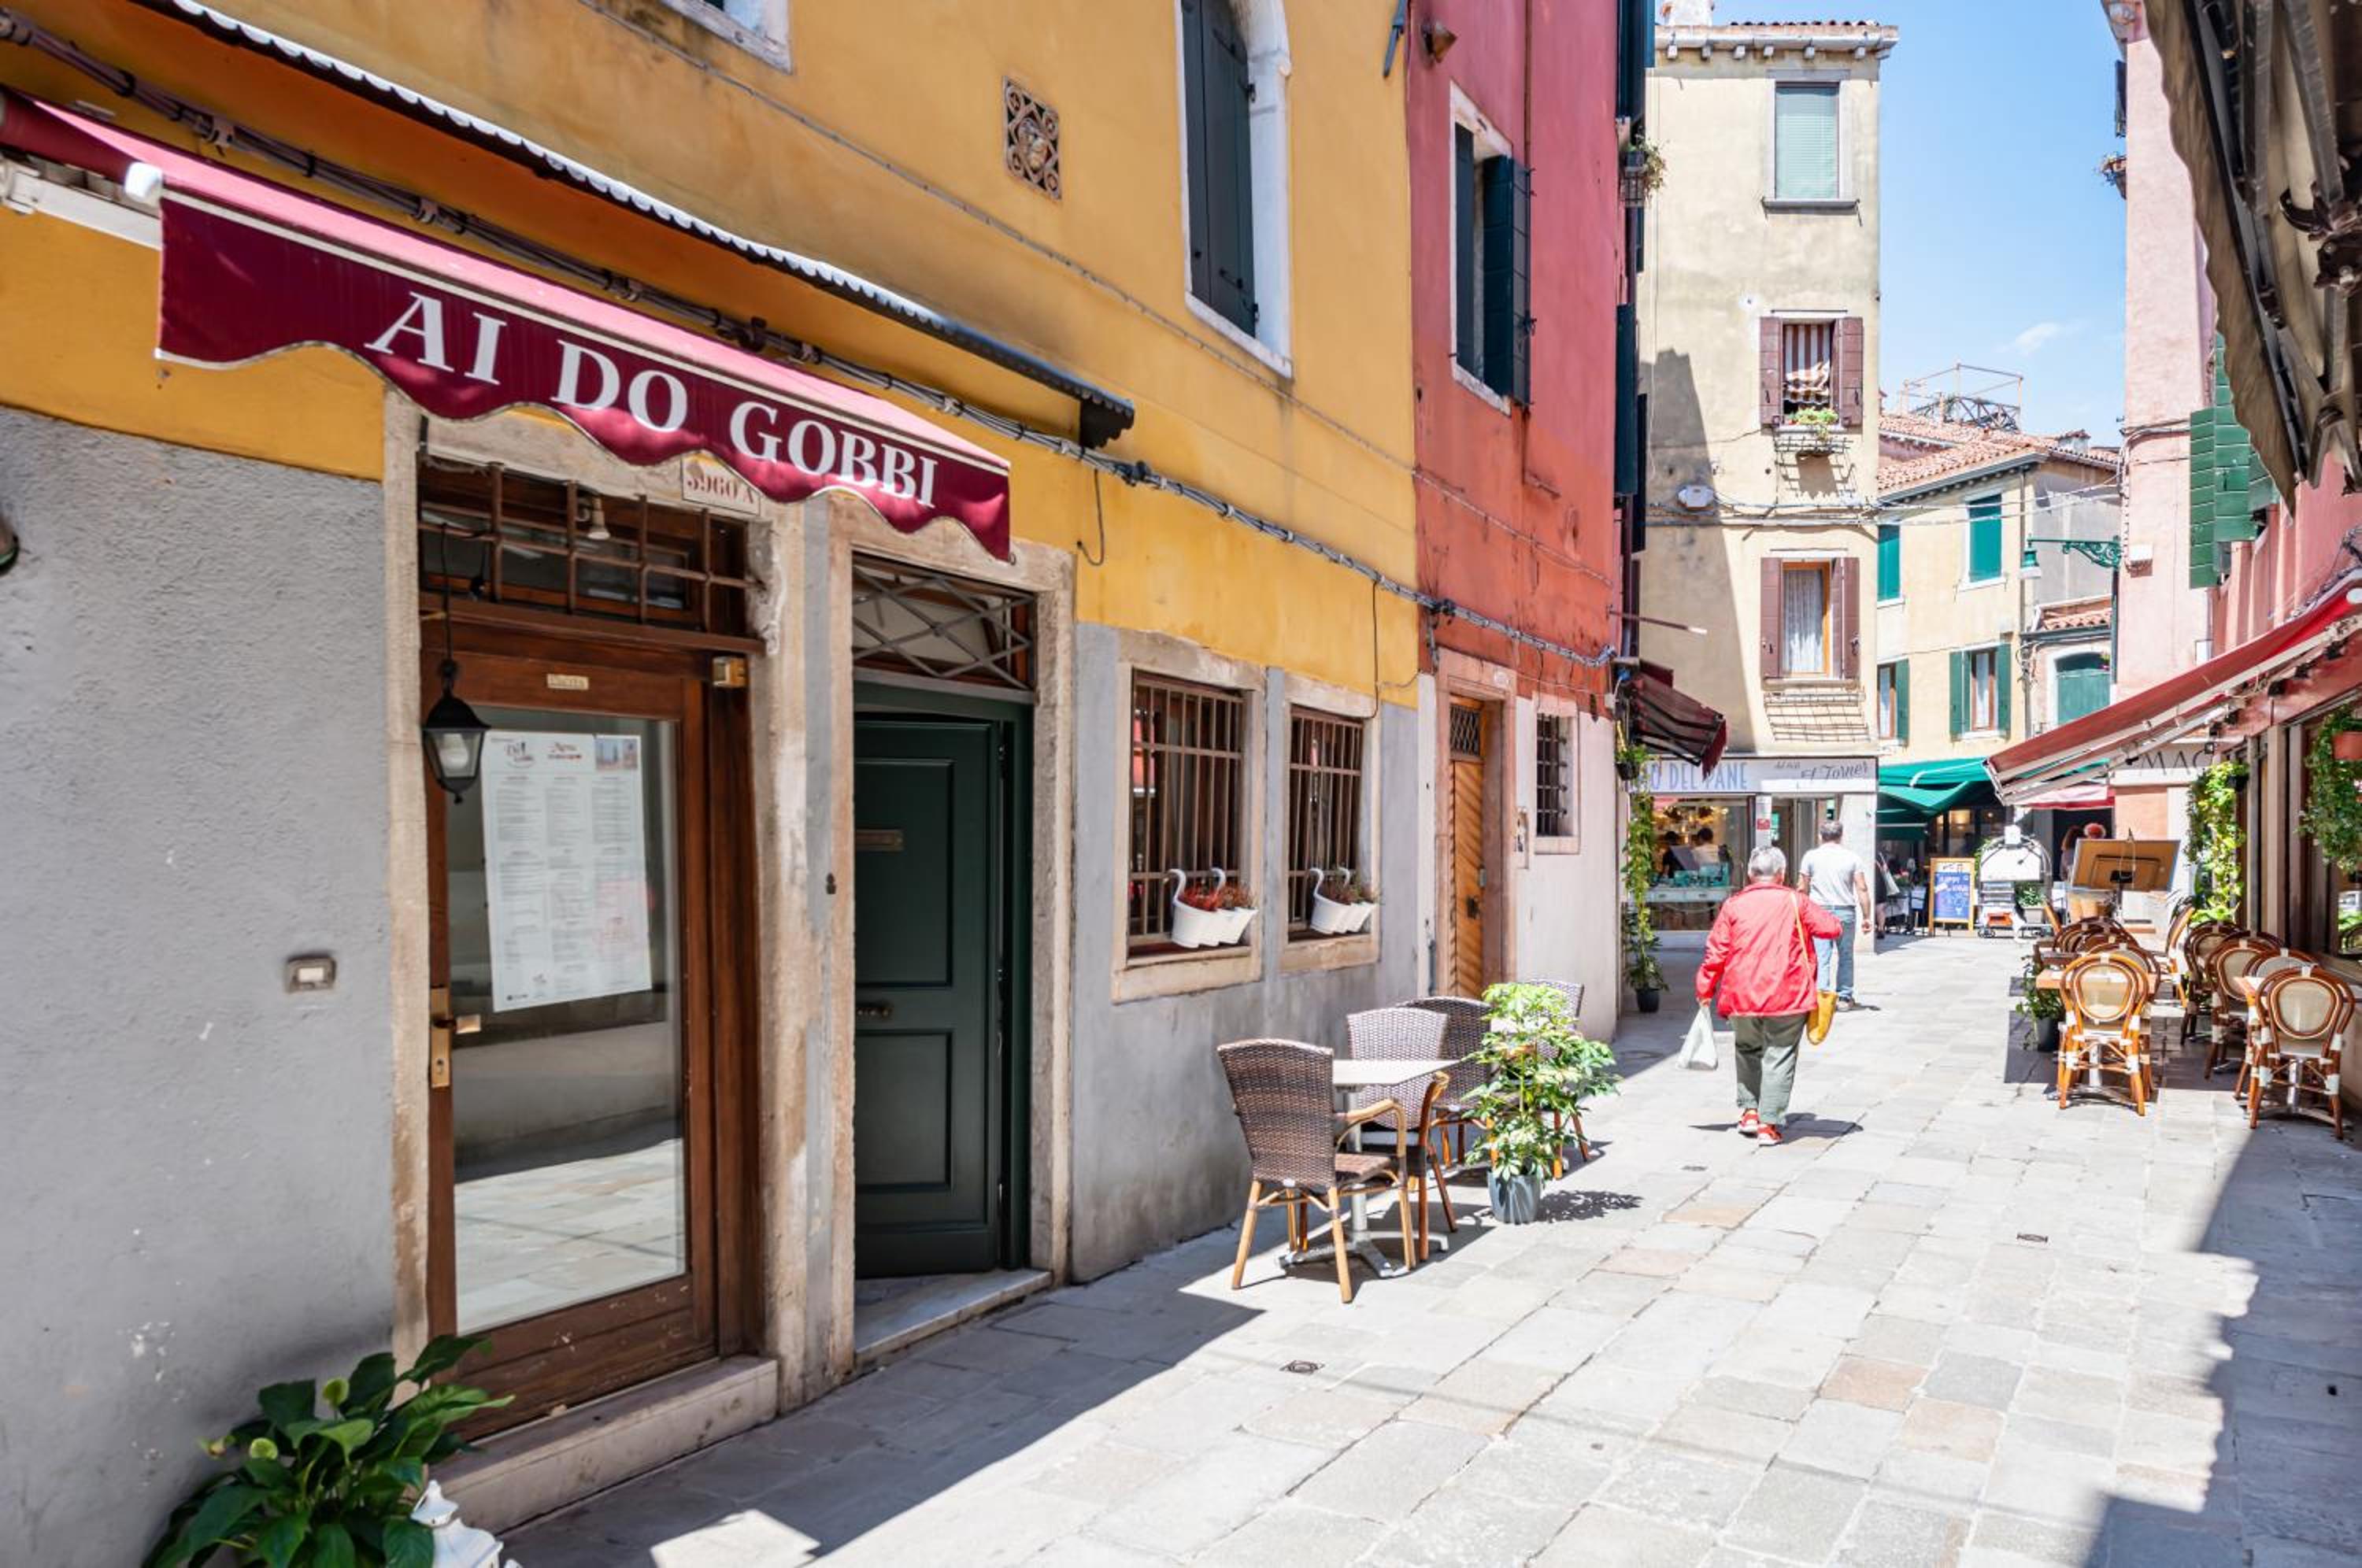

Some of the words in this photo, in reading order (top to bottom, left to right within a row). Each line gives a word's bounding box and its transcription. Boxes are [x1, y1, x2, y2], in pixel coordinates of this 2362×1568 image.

[365, 291, 508, 386] AI
[550, 339, 687, 432] DO
[729, 401, 939, 508] GOBBI
[1670, 763, 1698, 789] DEL
